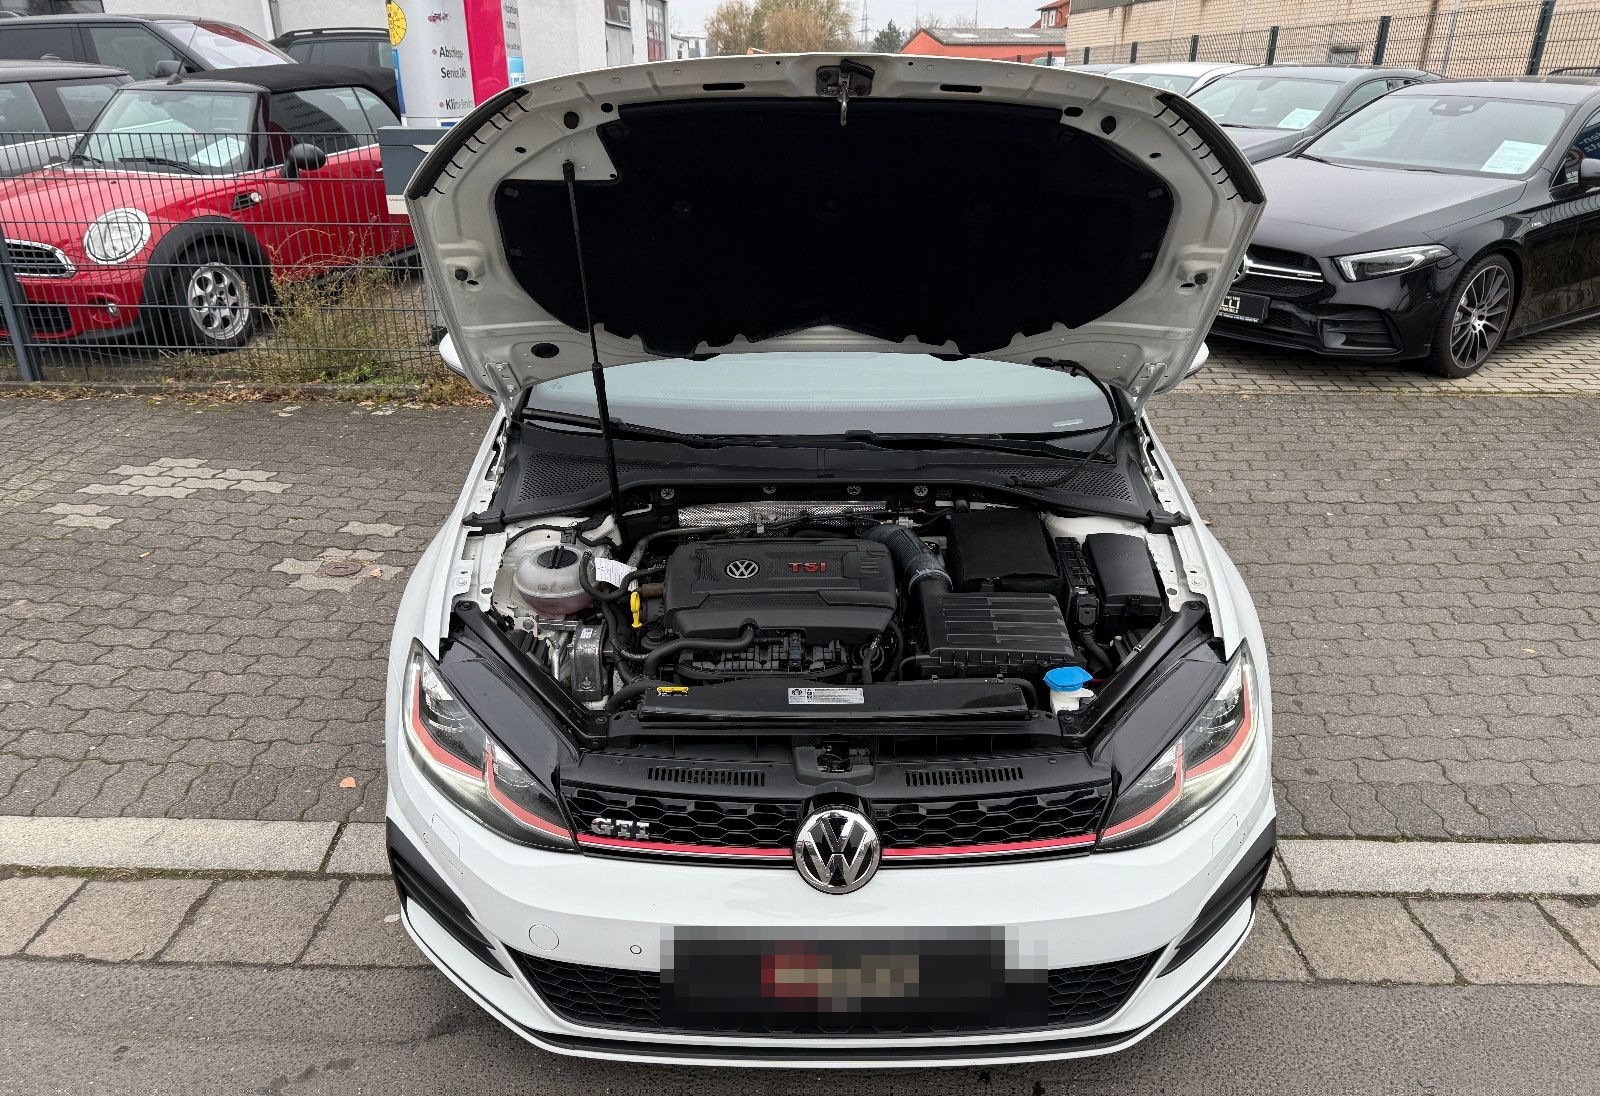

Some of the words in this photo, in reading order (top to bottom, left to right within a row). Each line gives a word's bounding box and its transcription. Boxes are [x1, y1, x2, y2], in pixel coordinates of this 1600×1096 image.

[441, 67, 459, 79] Service
[788, 562, 827, 573] TSI
[591, 817, 650, 839] GTI
